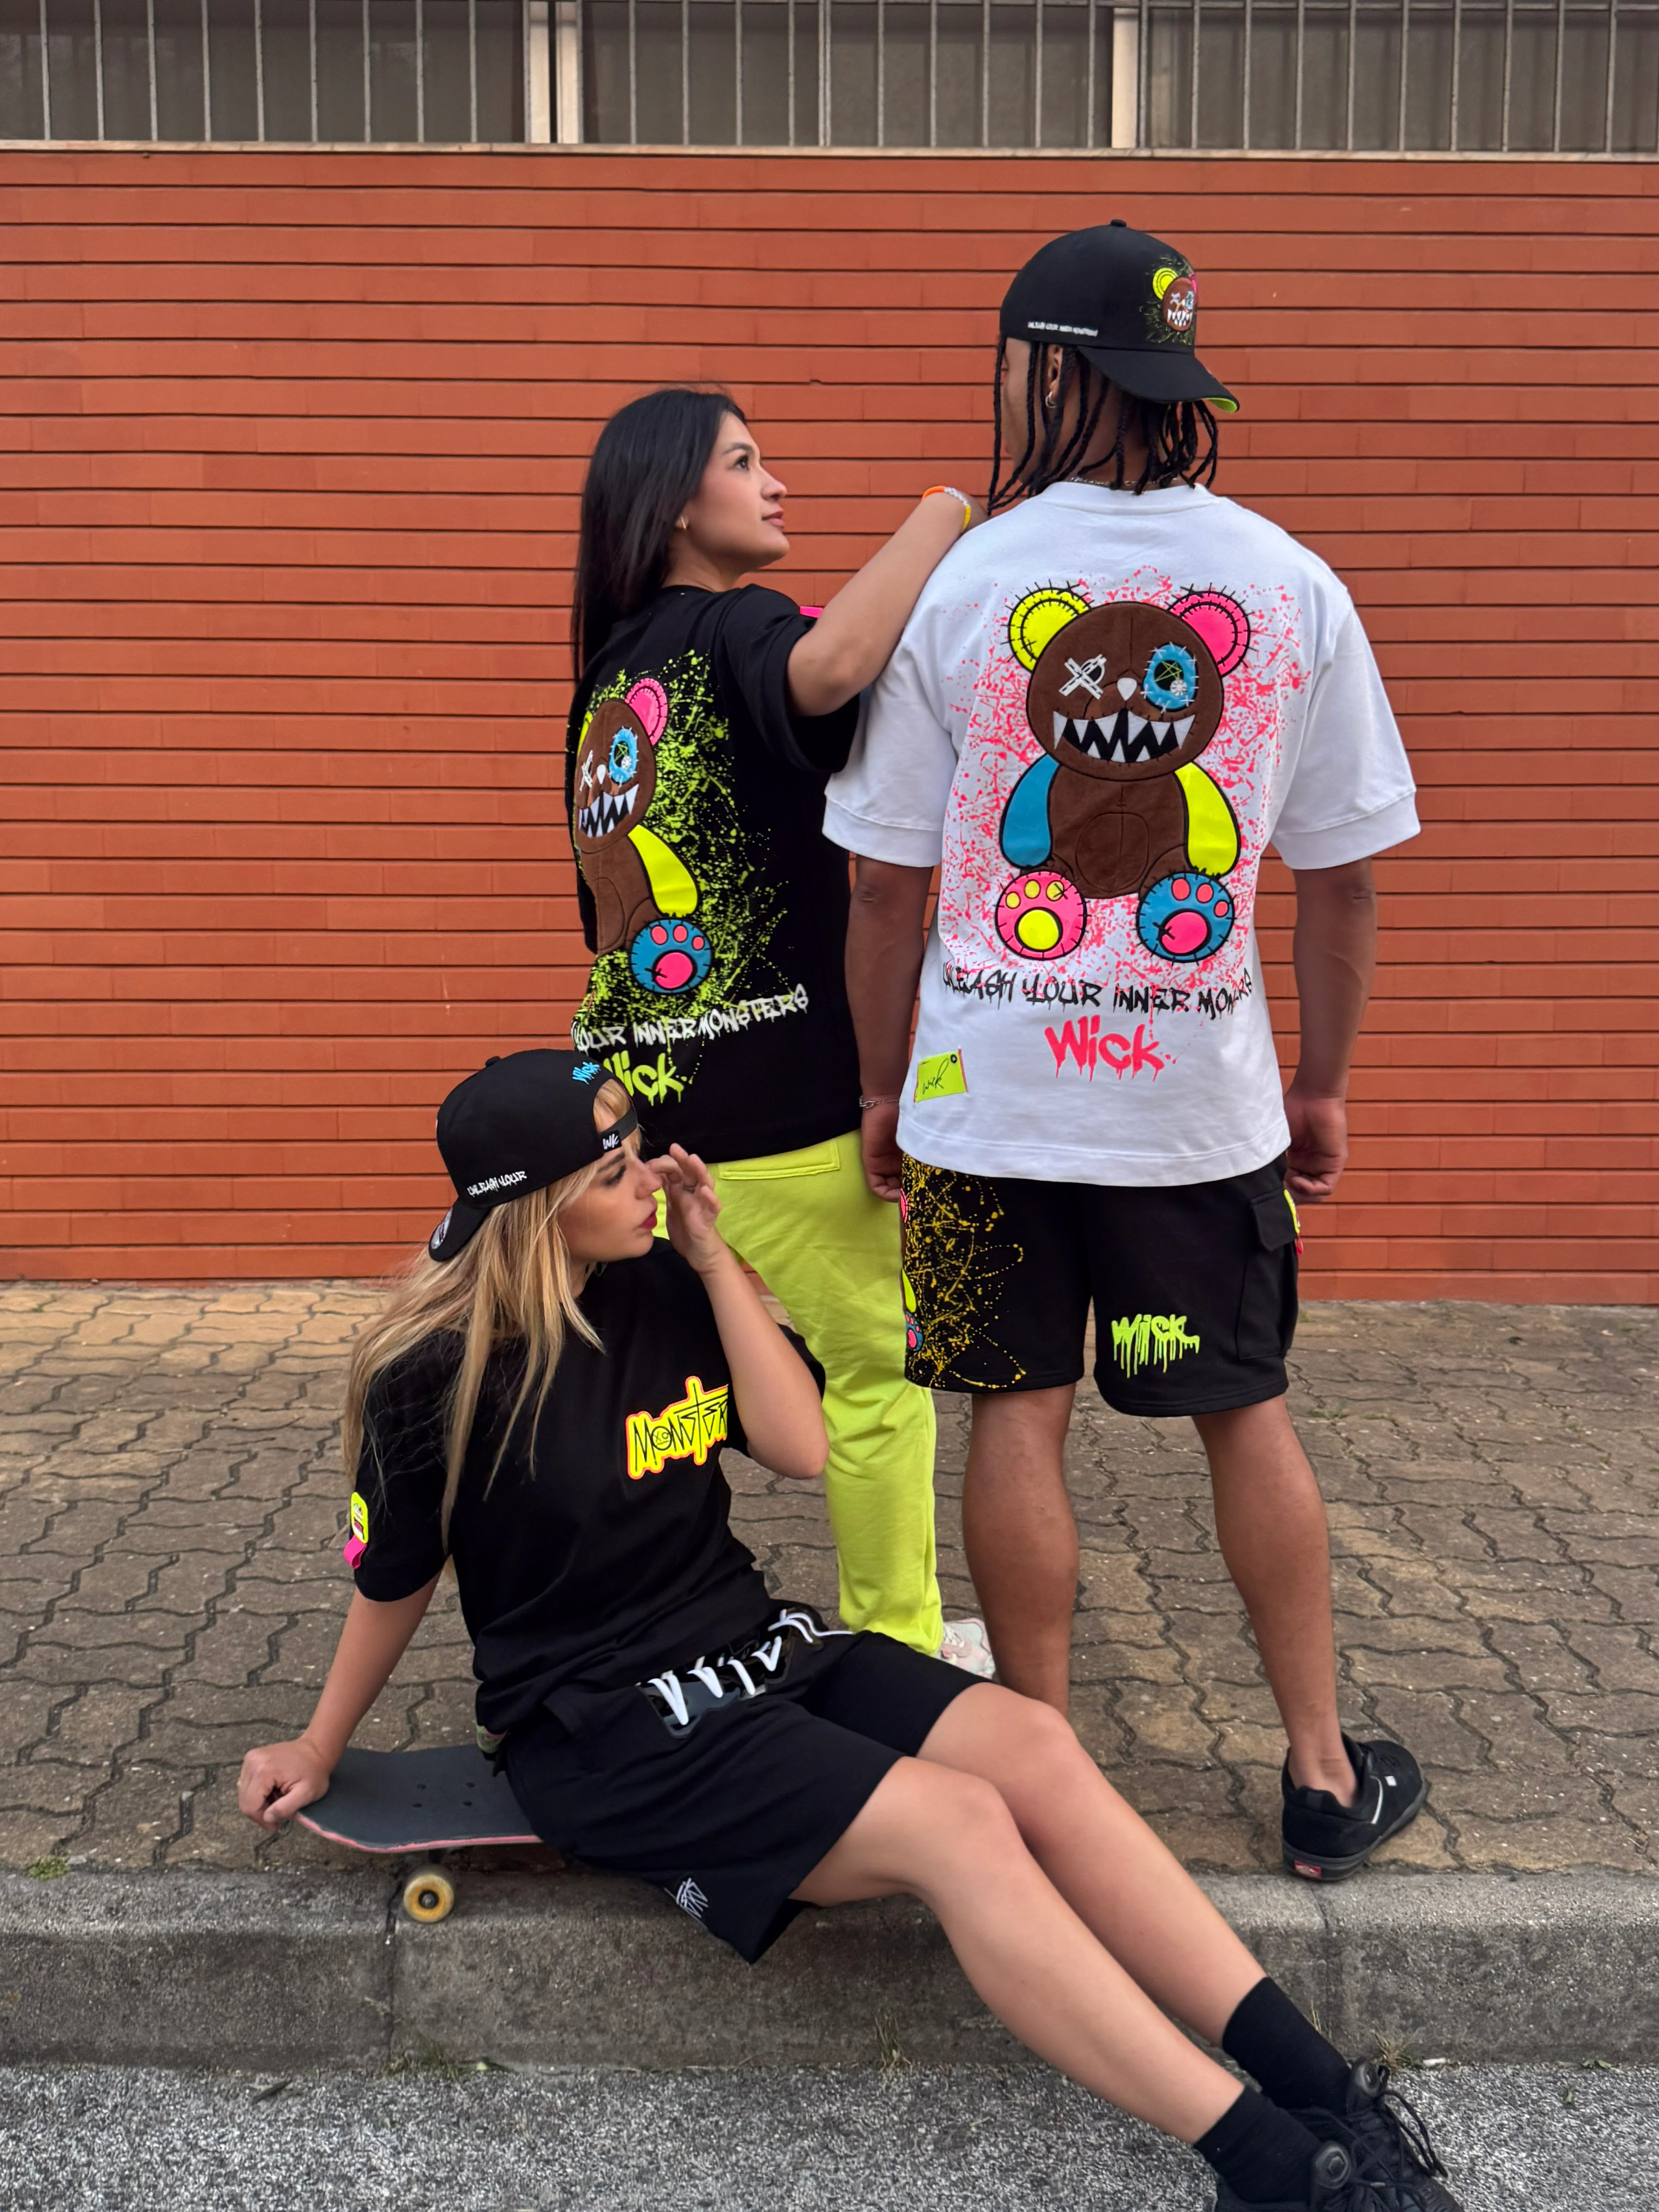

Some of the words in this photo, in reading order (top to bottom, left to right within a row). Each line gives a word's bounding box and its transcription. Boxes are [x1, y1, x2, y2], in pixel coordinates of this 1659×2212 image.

[1021, 973, 1103, 1012] YOUR
[1113, 982, 1190, 1015] INNER
[633, 1016, 697, 1048] INNER
[697, 983, 809, 1040] MONSTERS
[498, 1171, 527, 1187] YOUR
